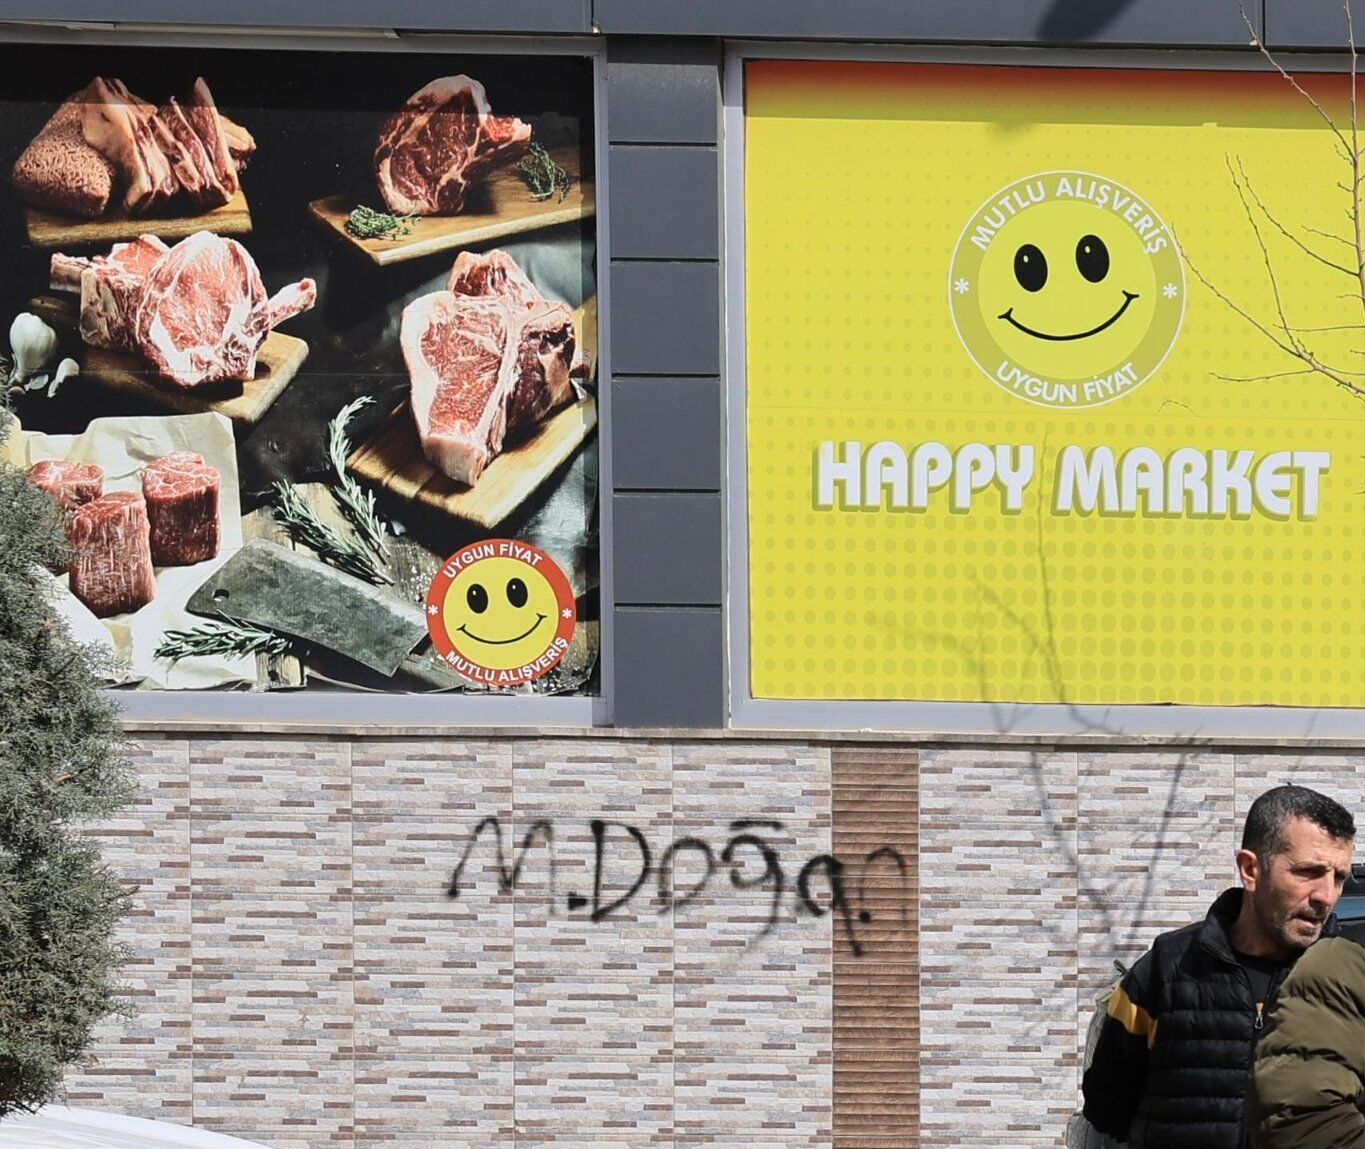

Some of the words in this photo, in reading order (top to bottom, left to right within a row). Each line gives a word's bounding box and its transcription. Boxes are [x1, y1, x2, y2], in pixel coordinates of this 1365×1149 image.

[971, 181, 1046, 250] MUTLU
[1056, 177, 1168, 254] ALIŞVERİŞ
[996, 360, 1077, 403] UYGUN
[1084, 363, 1138, 401] FİYAT
[813, 440, 1034, 512] HAPPY
[1053, 445, 1331, 521] MARKET
[443, 544, 495, 579] UYGUN
[499, 542, 543, 567] FİYAT
[446, 650, 495, 682] MUTLU
[498, 636, 569, 682] ALIŞVERİŞ
